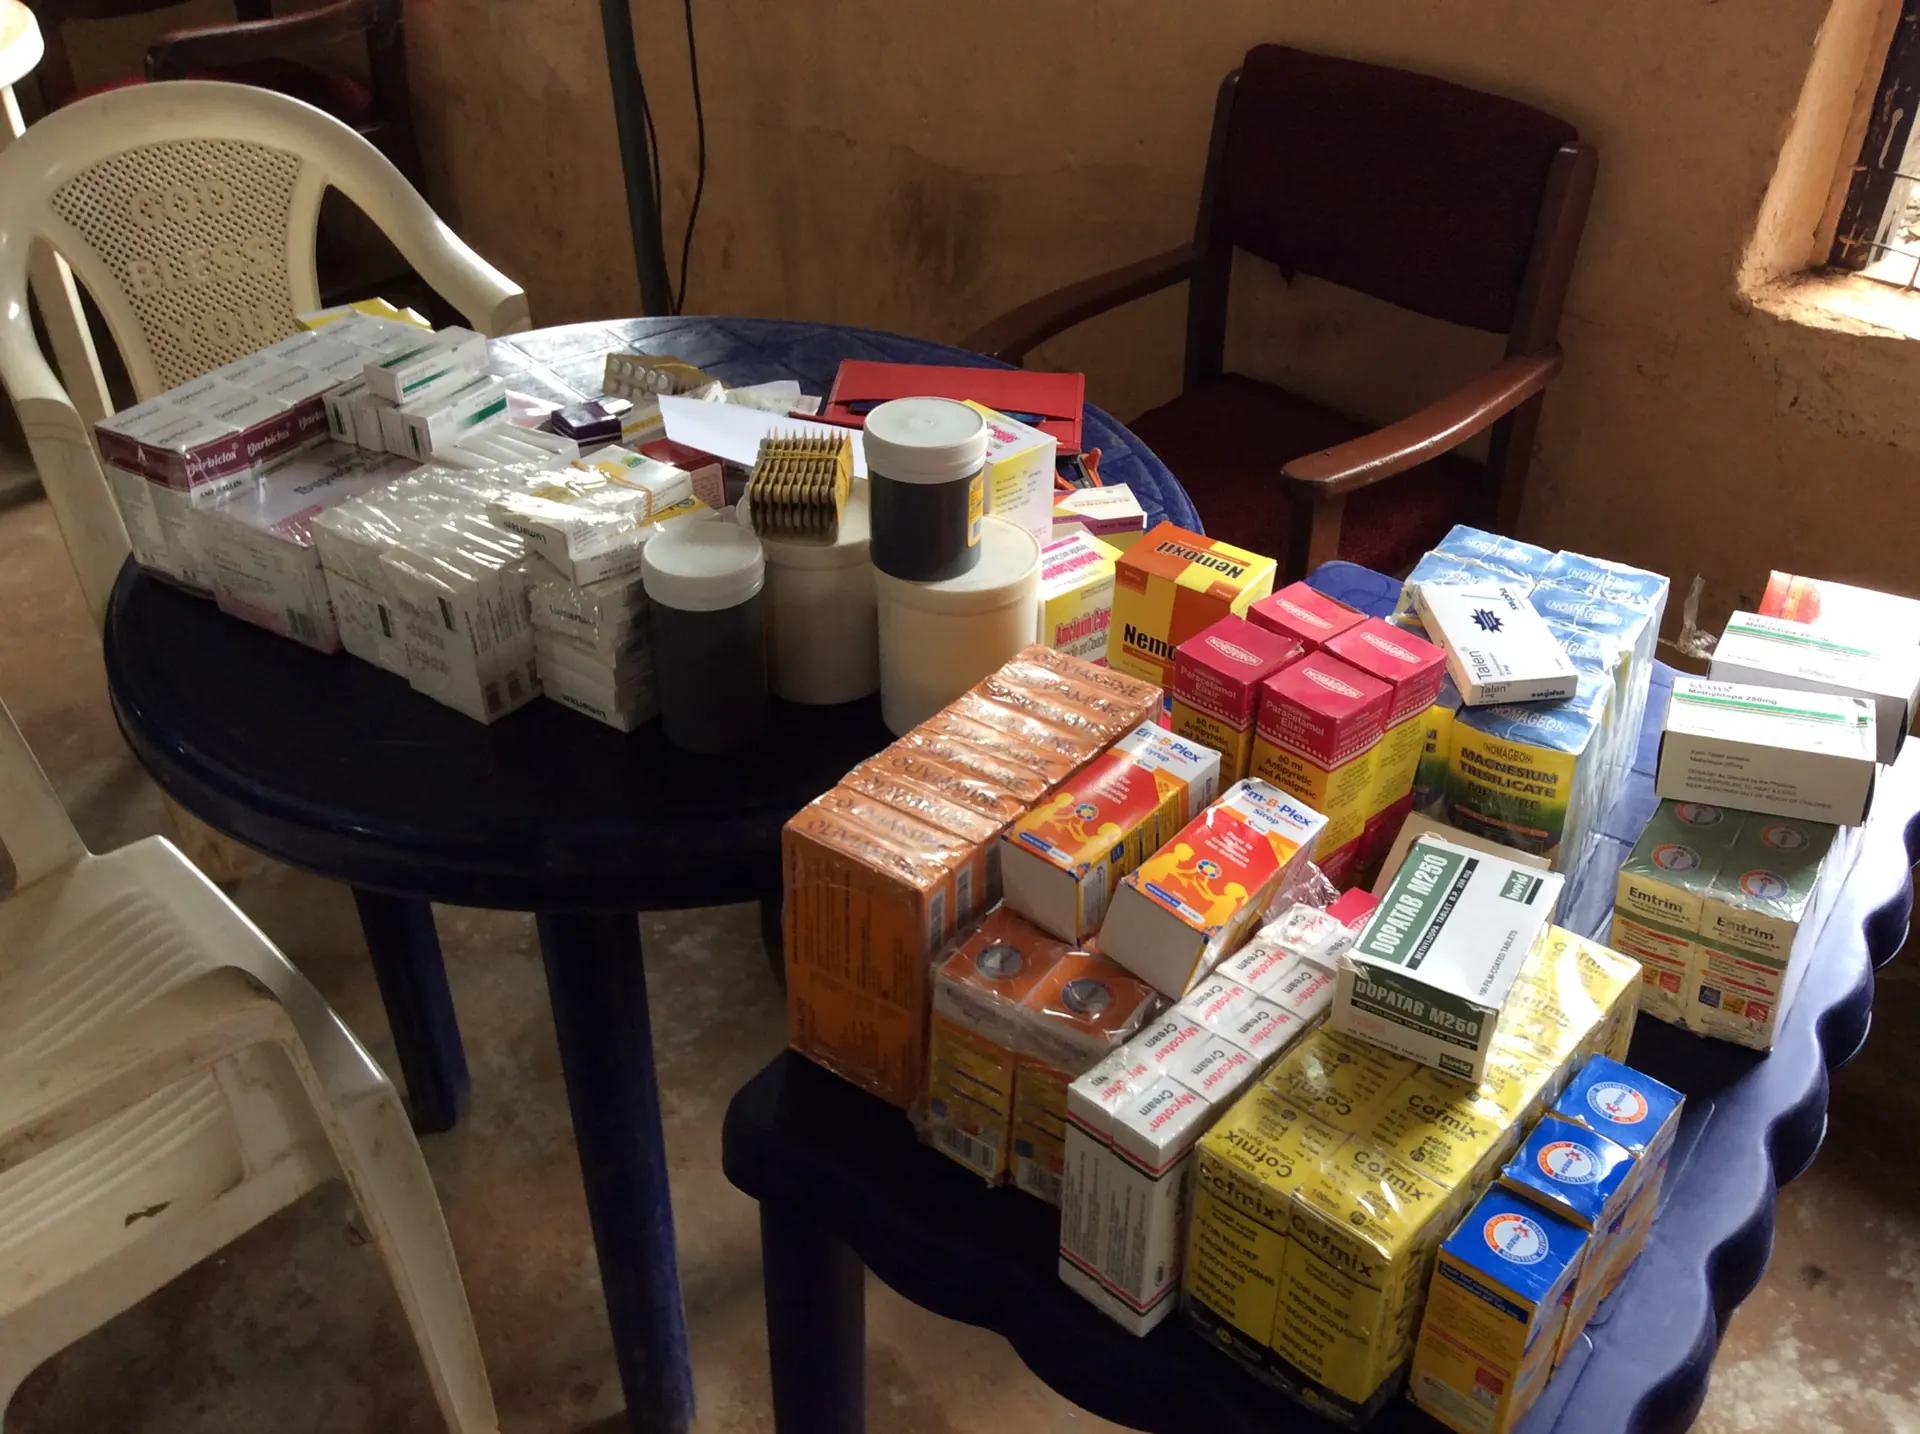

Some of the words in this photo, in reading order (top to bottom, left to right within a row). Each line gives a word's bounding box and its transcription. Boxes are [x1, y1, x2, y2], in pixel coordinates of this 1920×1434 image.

[1157, 542, 1244, 578] Nemoxil
[1124, 623, 1177, 660] Nemo
[1181, 665, 1236, 699] Paracetamol
[1469, 650, 1493, 681] Talen
[1266, 701, 1325, 737] Paracetamol
[1280, 717, 1305, 736] Elixir
[1265, 757, 1312, 786] Antipyretic
[1459, 747, 1559, 785] MAGNESIUM
[1459, 761, 1556, 798] TRISILICATE
[1241, 783, 1312, 827] Em-B-Plex
[1253, 808, 1279, 826] Sirop
[1370, 893, 1424, 954] DOPATAB
[1407, 853, 1448, 896] M250
[1506, 874, 1529, 900] hovid
[1629, 886, 1684, 913] Emtrim
[1436, 902, 1452, 927] TABLET
[1716, 916, 1775, 942] Emtrim
[1237, 949, 1265, 971] Cream
[1247, 949, 1288, 985] Mycoten
[1283, 970, 1313, 995] Cream
[1203, 985, 1246, 1022] Mycoten
[1355, 980, 1425, 1017] DOPATAB
[1429, 1007, 1479, 1037] M250
[1143, 1023, 1178, 1048] Cream
[1238, 1011, 1271, 1036] Cream
[1249, 1013, 1292, 1048] Mycoten
[1154, 1025, 1200, 1062] Mycoten
[1191, 1048, 1225, 1075] Cream
[1202, 1049, 1249, 1090] Mycoten
[1138, 1089, 1175, 1117] Cream
[1150, 1090, 1198, 1133] Mycoten
[1408, 1094, 1480, 1140] Cofmix
[1224, 1130, 1293, 1179] Cofmix
[1200, 1161, 1275, 1221] Cofmix
[1353, 1150, 1428, 1201] Cofmix
[1222, 1234, 1259, 1260] RELIEF
[1292, 1213, 1372, 1278] Cofmix
[1229, 1255, 1275, 1287] COUGHS
[1286, 1304, 1336, 1344] SOOTHES
[1312, 1293, 1350, 1320] RELIEF
